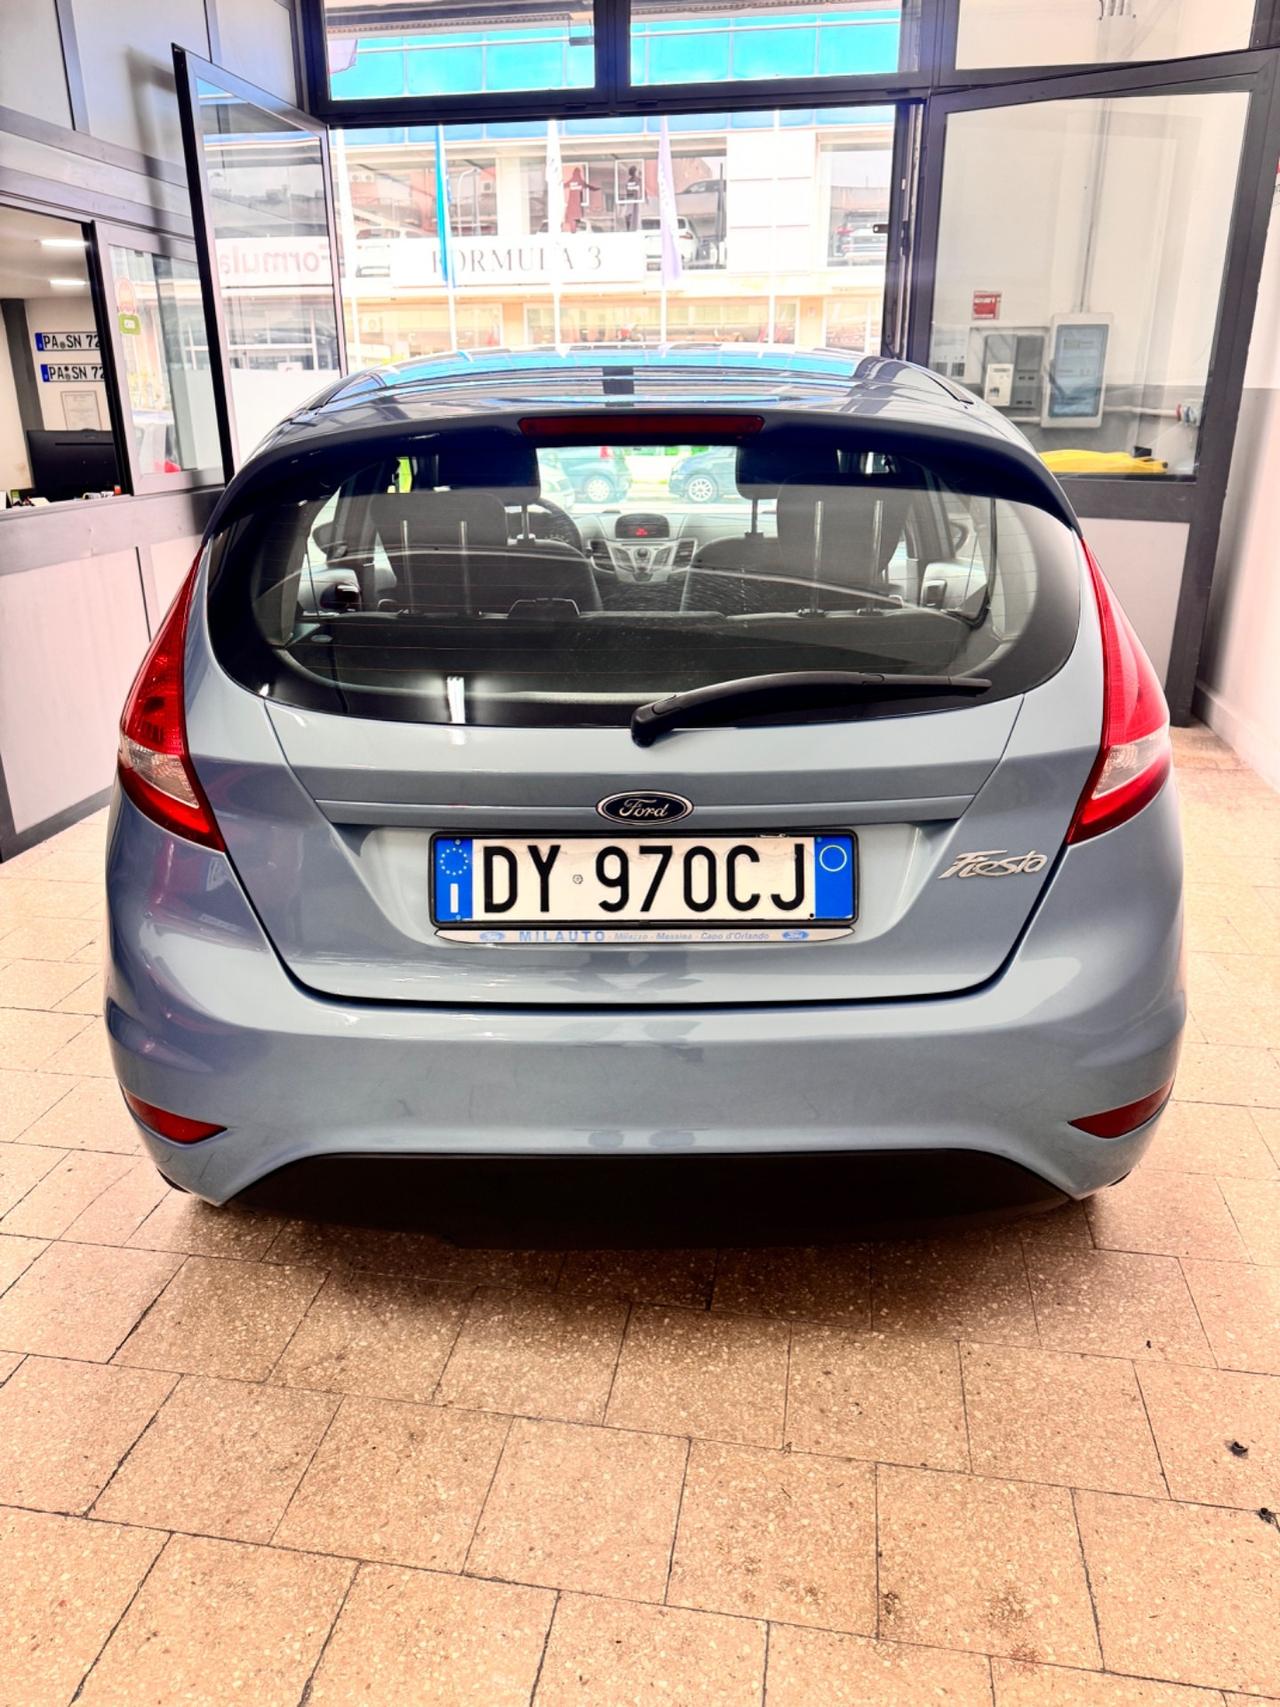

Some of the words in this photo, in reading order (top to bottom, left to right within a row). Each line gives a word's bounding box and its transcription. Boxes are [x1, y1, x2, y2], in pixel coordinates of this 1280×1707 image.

[588, 246, 602, 270] 3
[43, 335, 58, 349] PA
[66, 334, 82, 348] SN
[49, 366, 64, 380] PA
[71, 366, 87, 380] SN
[619, 798, 670, 817] Ford
[938, 850, 1048, 879] Fiesta
[483, 844, 561, 913] DY
[595, 843, 805, 913] 970CJ
[519, 931, 605, 942] MILAUTO
[701, 932, 725, 942] Capo
[727, 932, 769, 941] d'Orlando
